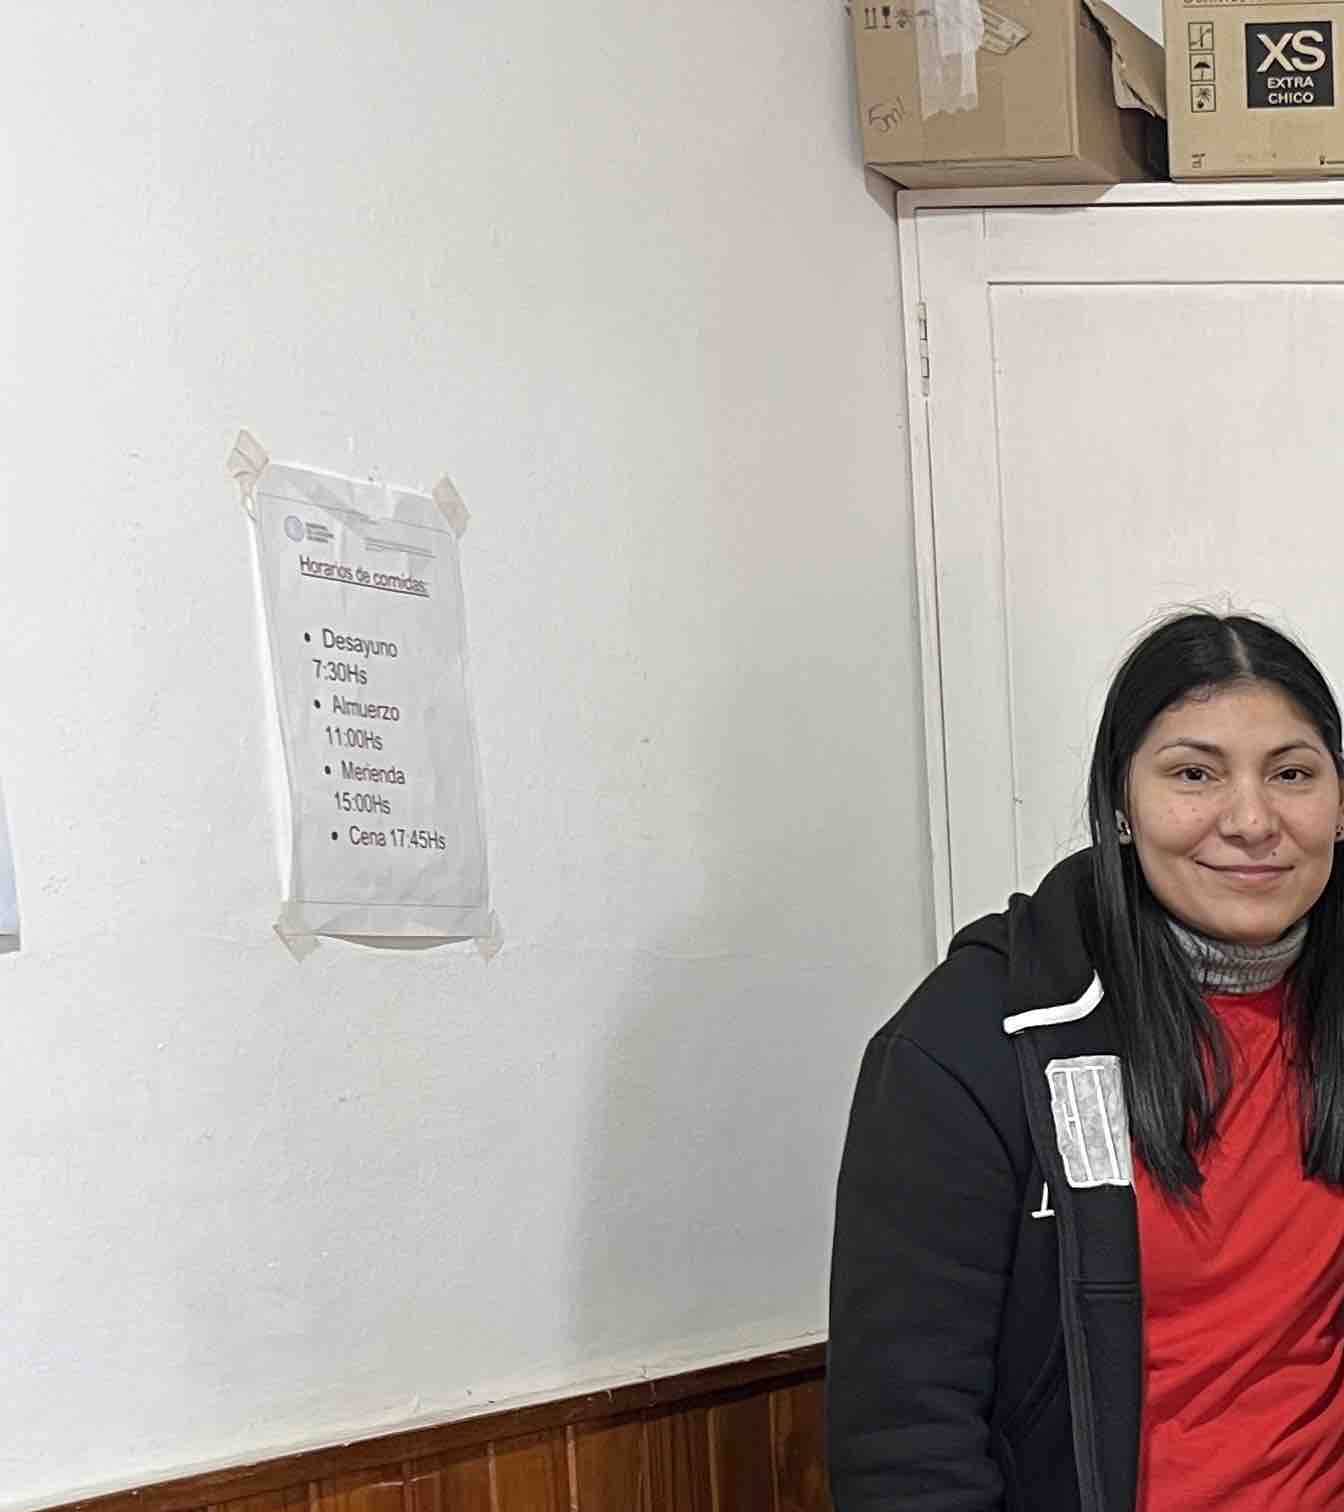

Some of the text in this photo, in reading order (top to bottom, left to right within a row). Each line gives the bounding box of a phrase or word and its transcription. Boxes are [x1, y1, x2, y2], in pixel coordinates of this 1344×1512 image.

[1256, 29, 1326, 73] XS
[1267, 76, 1314, 90] EXTRA
[1268, 91, 1314, 104] CHICO
[299, 554, 353, 581] Horarios
[355, 565, 371, 584] de
[322, 628, 398, 658] Desayuno
[312, 659, 368, 685] 7:30Hs
[332, 694, 401, 722] Almuerzo
[326, 725, 384, 751] 11:00Hs
[341, 760, 406, 785] Merienda
[334, 791, 391, 815] 15:00Hs
[349, 825, 387, 847] Cena
